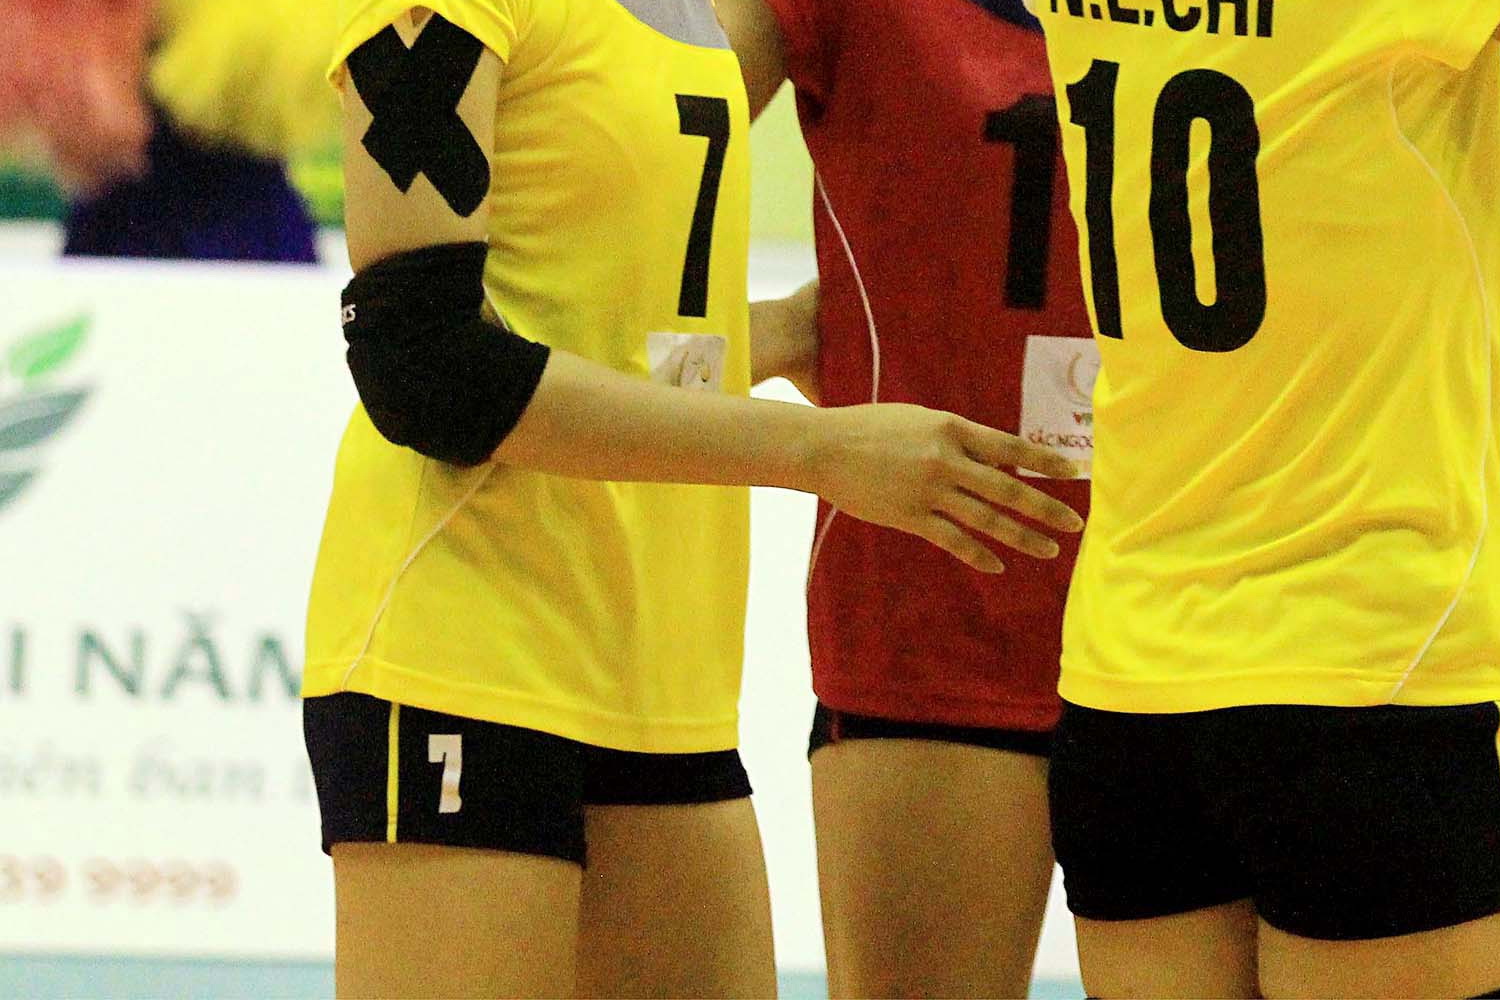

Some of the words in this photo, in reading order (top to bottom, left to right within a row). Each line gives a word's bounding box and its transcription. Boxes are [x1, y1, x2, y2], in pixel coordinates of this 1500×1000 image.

[674, 93, 731, 317] 7
[1065, 58, 1267, 352] 10
[428, 734, 463, 813] 7
